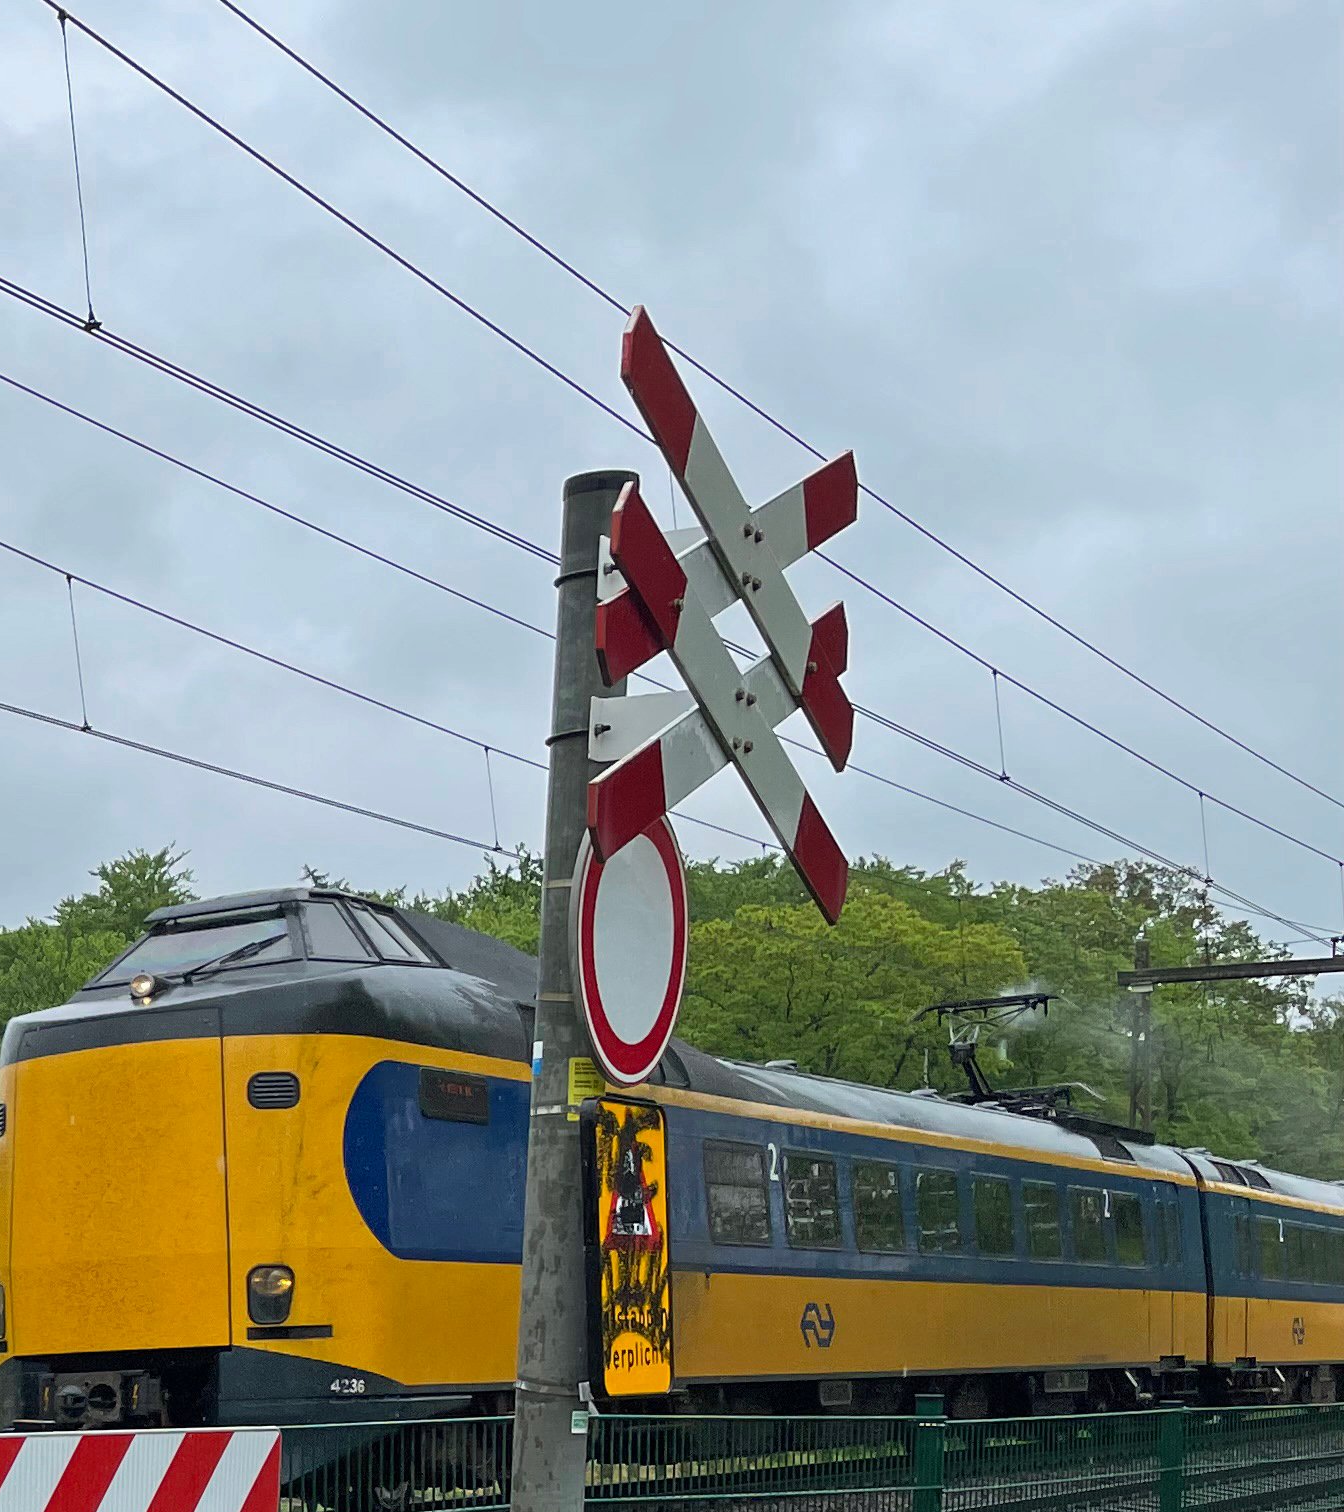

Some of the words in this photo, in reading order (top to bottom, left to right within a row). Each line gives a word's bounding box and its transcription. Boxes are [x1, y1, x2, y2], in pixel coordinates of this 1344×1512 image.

[768, 1142, 780, 1181] 2
[605, 1341, 667, 1373] erplicht
[330, 1378, 365, 1393] 4236
